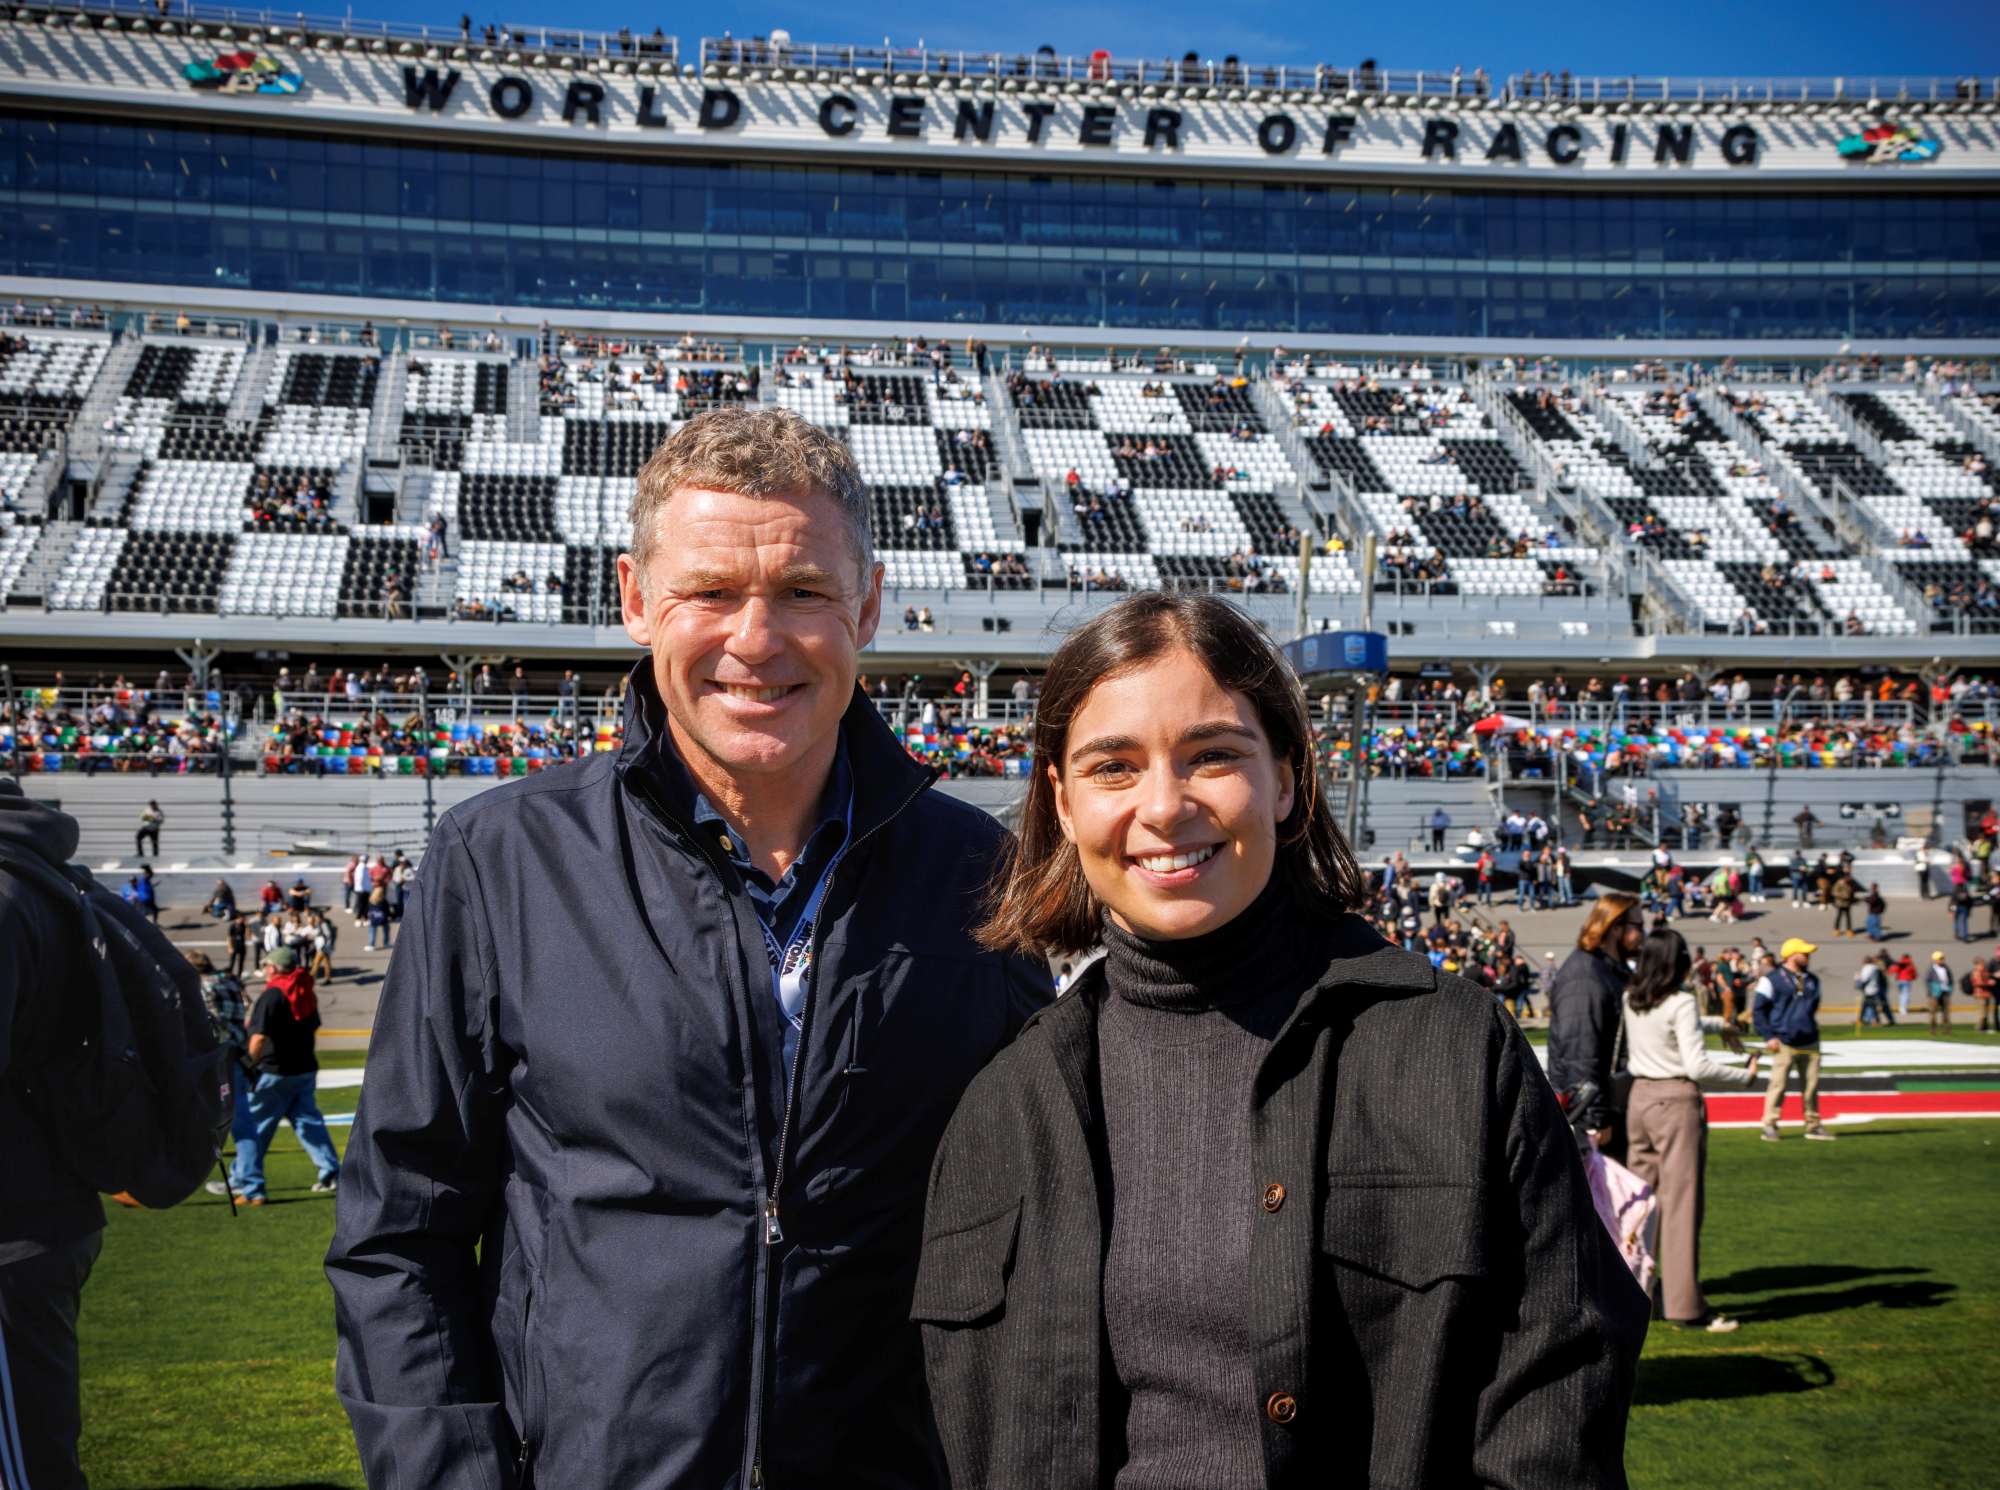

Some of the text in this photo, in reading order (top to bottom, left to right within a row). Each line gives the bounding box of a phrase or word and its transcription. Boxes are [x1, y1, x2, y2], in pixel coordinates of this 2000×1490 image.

[403, 65, 1759, 166] WORLD CENTER OF RACING
